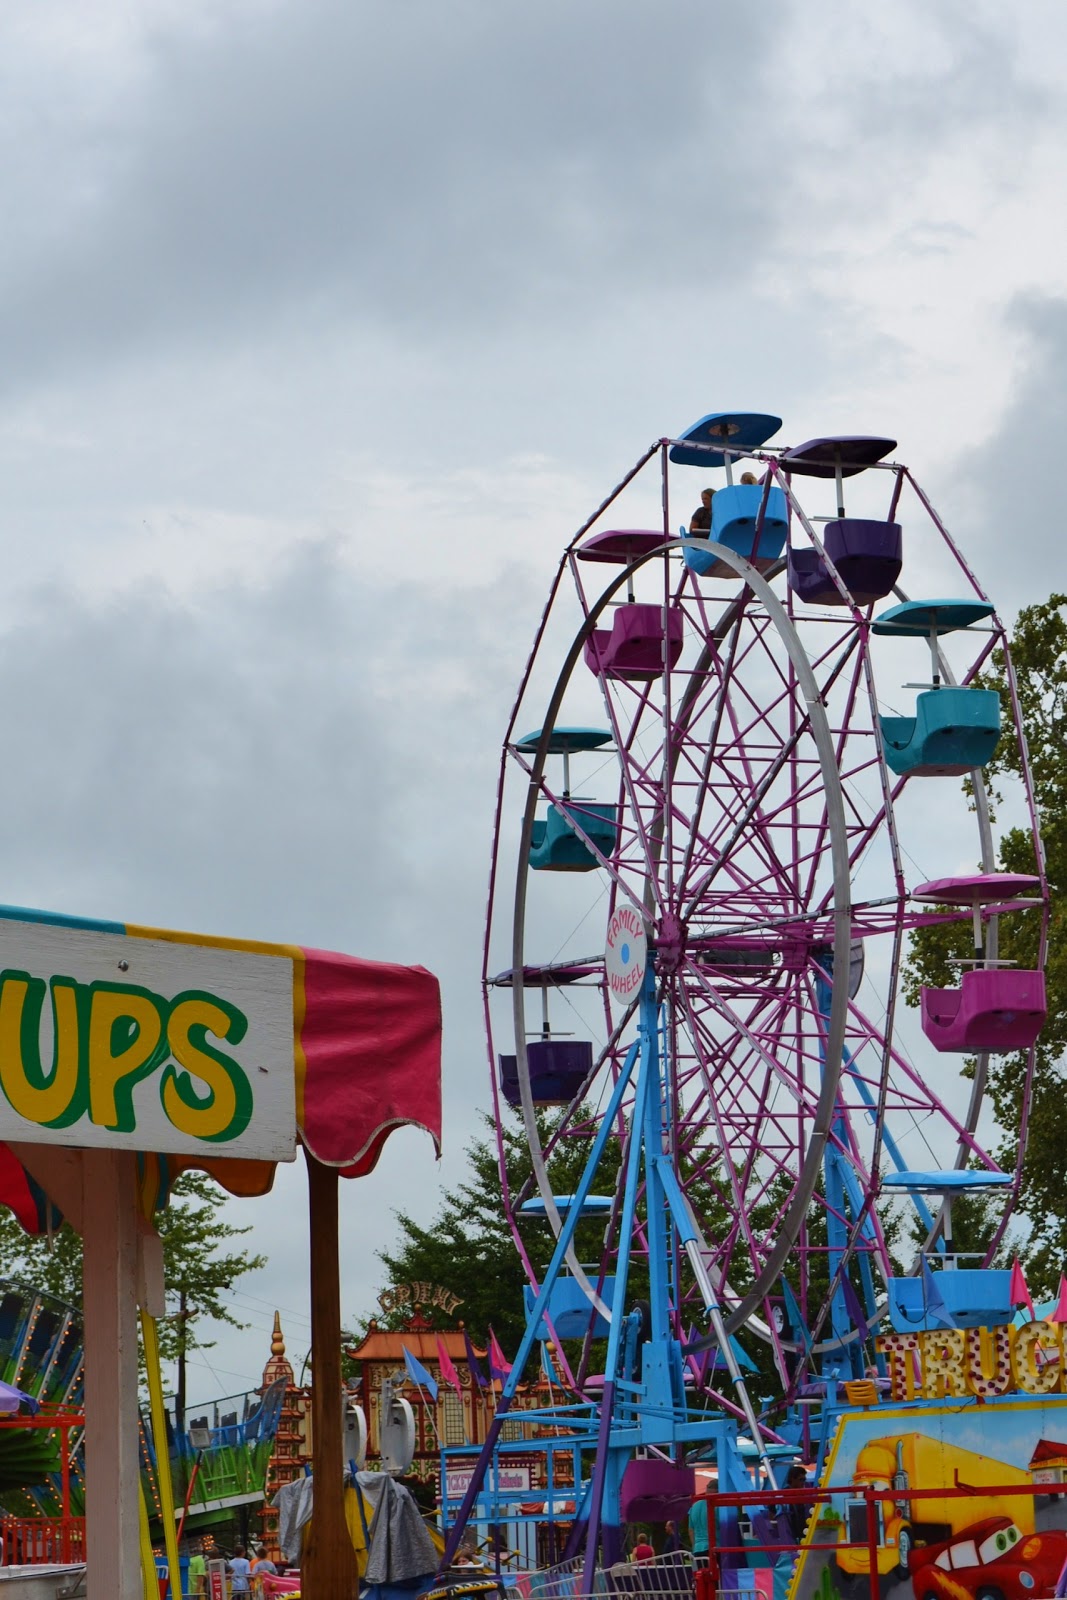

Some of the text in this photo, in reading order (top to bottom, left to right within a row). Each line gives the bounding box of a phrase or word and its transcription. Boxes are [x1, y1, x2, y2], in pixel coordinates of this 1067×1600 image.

[607, 909, 644, 948] FAMILY
[611, 963, 644, 994] WHEEL
[379, 1281, 465, 1316] ORIENT
[875, 1320, 1067, 1402] TRUC
